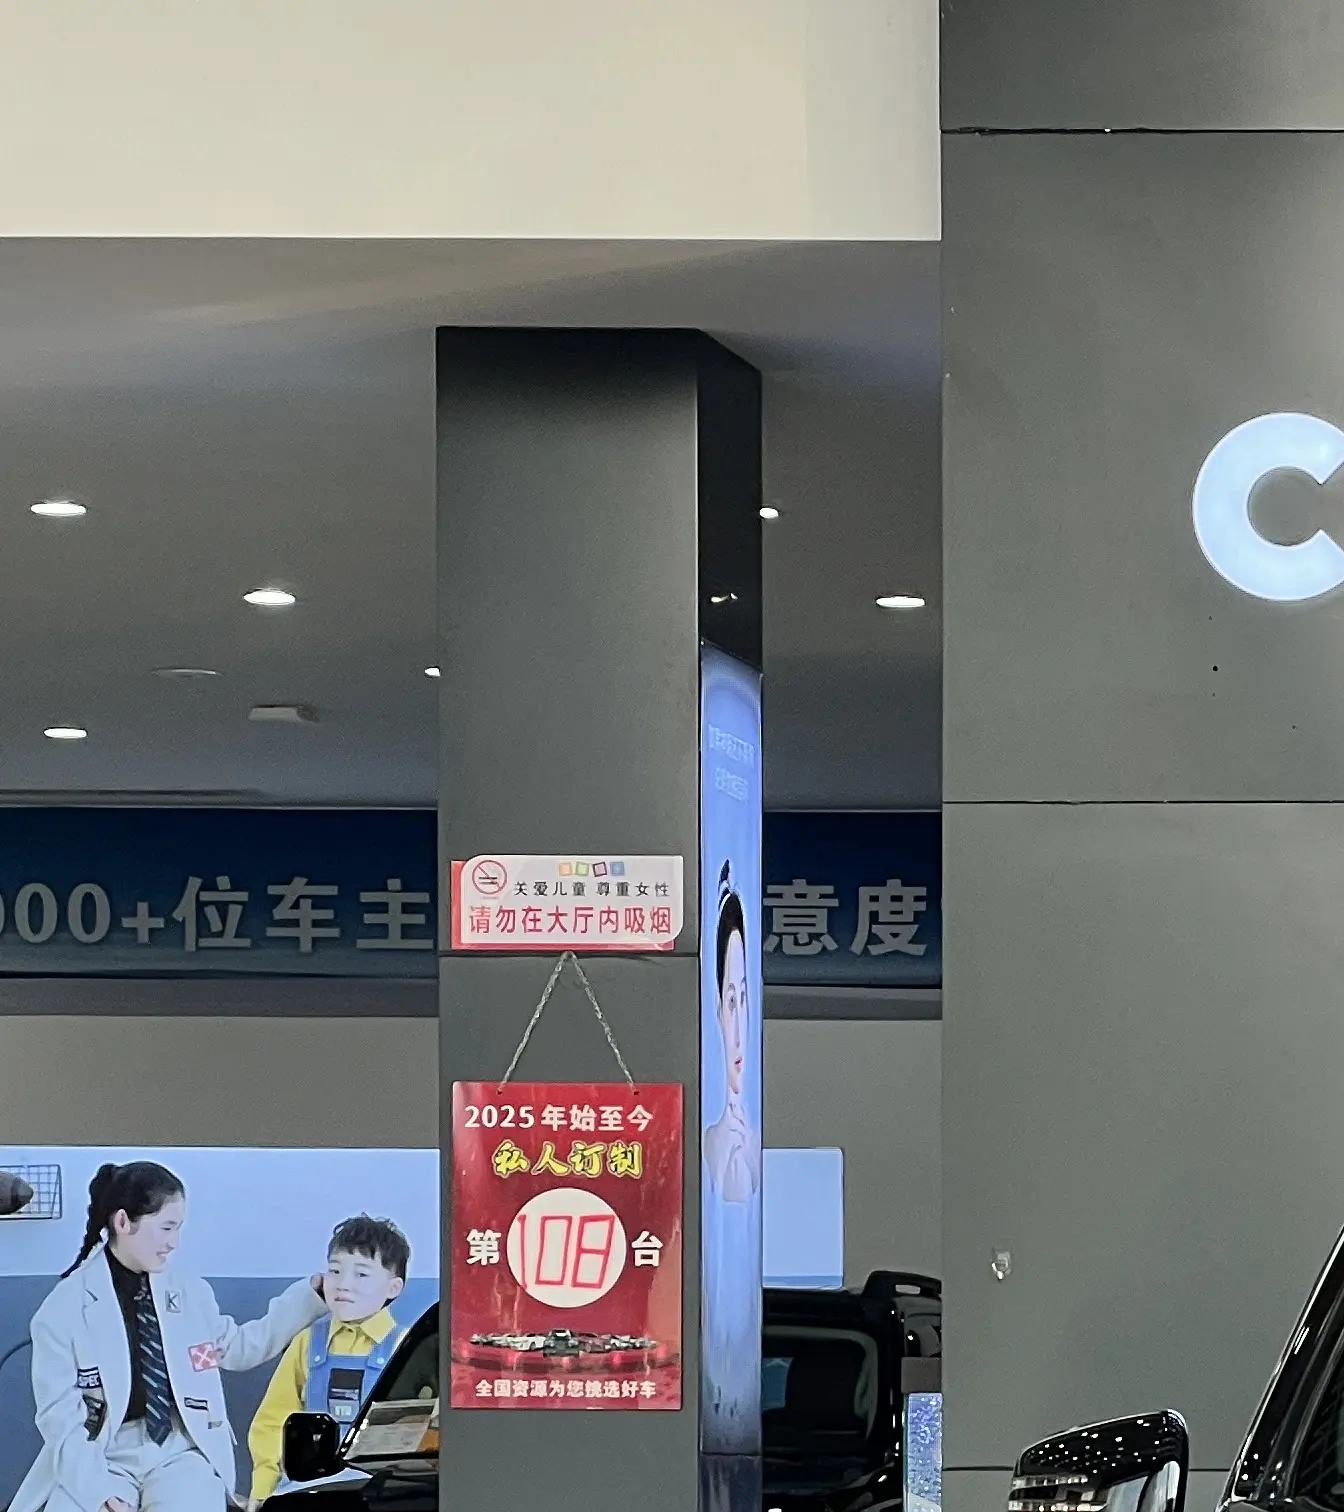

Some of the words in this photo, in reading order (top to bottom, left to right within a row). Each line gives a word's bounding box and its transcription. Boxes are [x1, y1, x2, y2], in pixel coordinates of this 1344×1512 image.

[514, 881, 587, 898] 关爱儿童
[596, 881, 671, 898] 尊重女性
[0, 875, 435, 953] 00+位车主
[763, 878, 928, 957] 意度
[469, 905, 672, 935] 请勿在大厅内吸烟
[493, 1139, 645, 1179] 私人订制
[466, 1229, 502, 1266] 第
[631, 1230, 665, 1267] 台
[475, 1379, 658, 1400] 全国资源为您挑选好车
